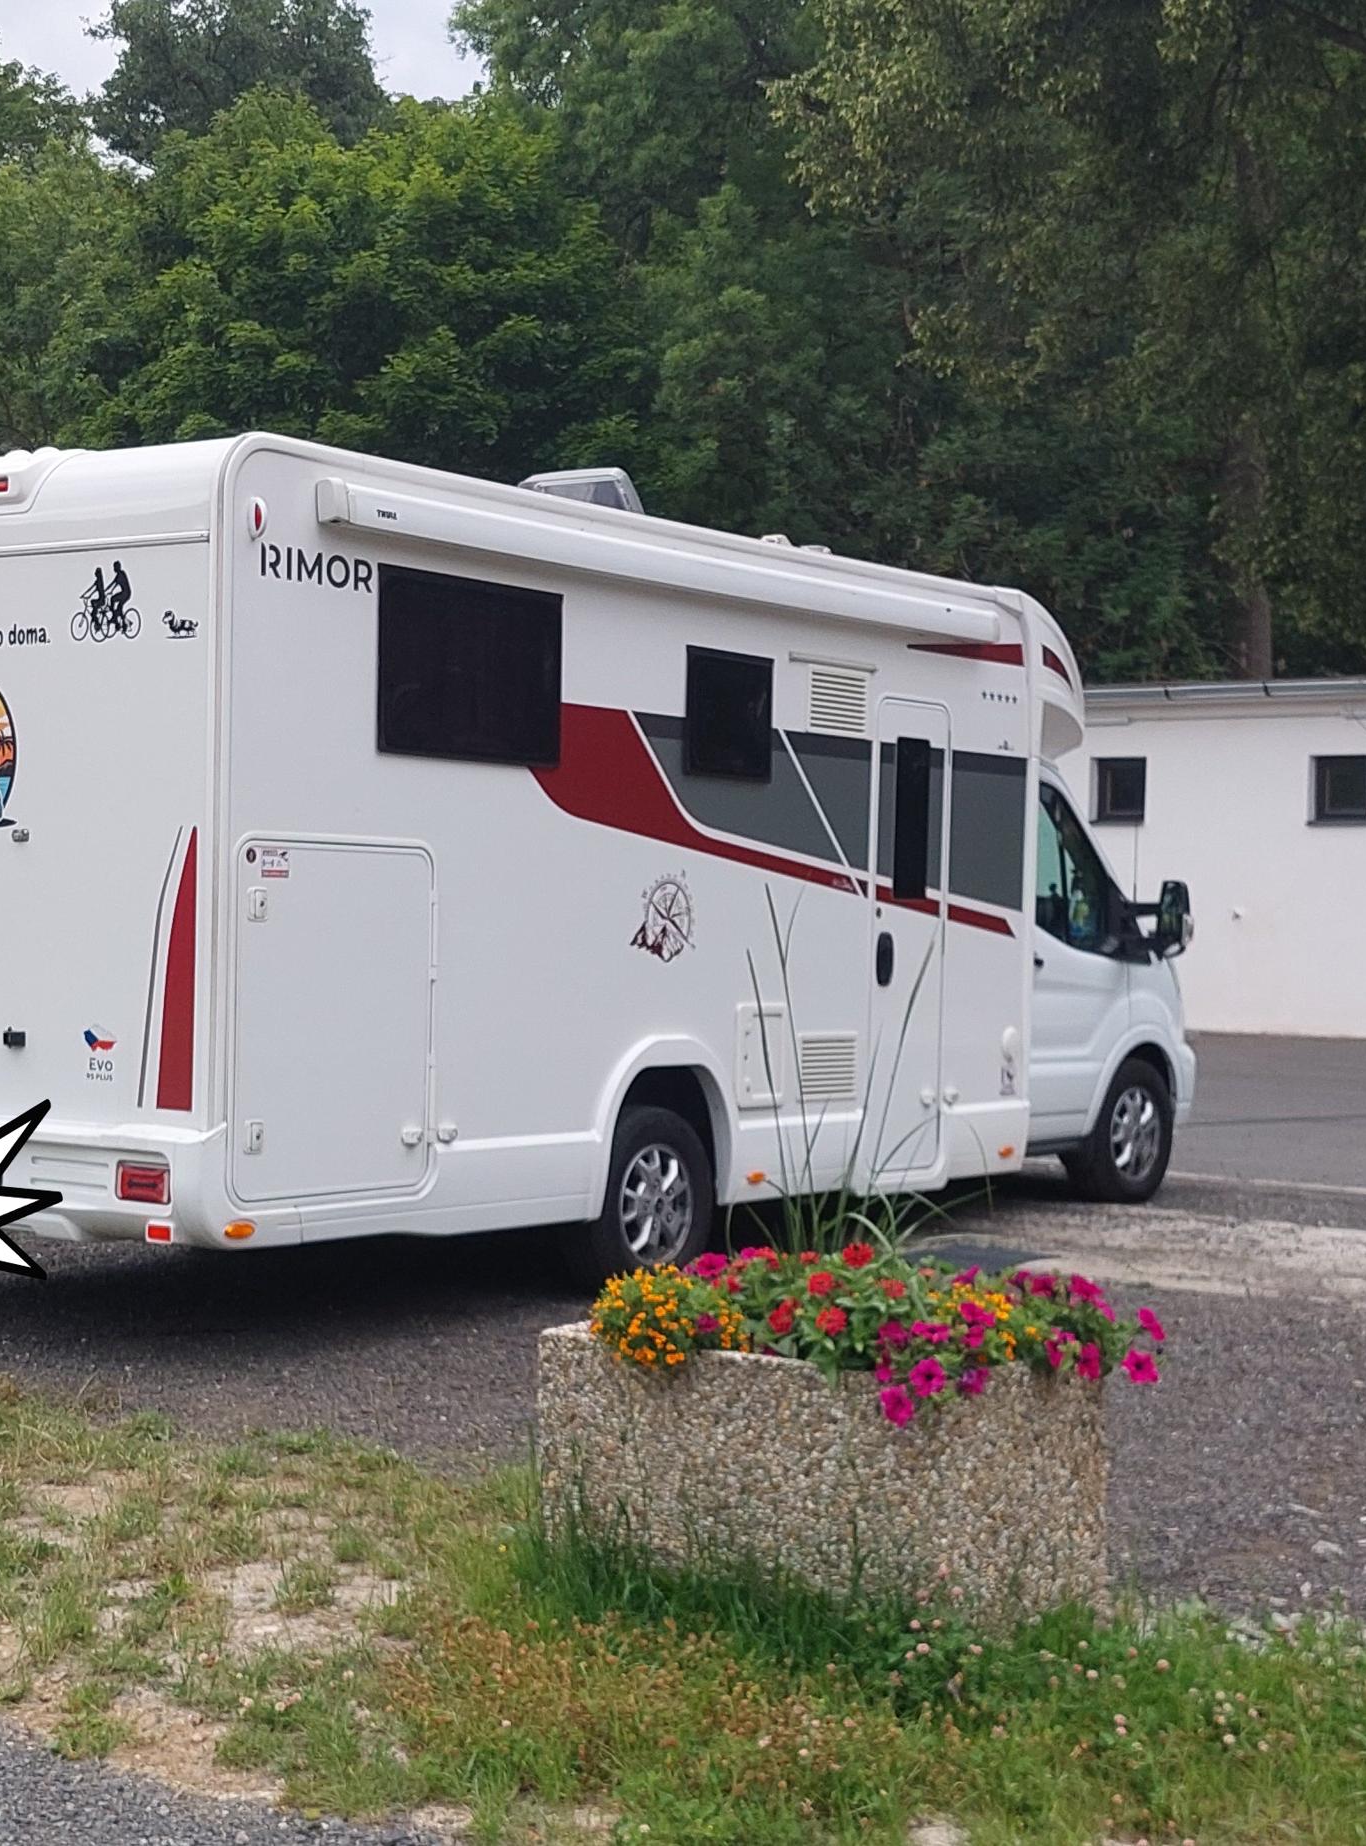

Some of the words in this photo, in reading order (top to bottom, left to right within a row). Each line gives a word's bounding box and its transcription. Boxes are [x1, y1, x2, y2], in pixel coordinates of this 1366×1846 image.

[261, 542, 373, 593] RIMOR
[8, 623, 51, 645] doma.
[89, 1057, 113, 1071] EVO
[96, 1073, 113, 1082] PLUS
